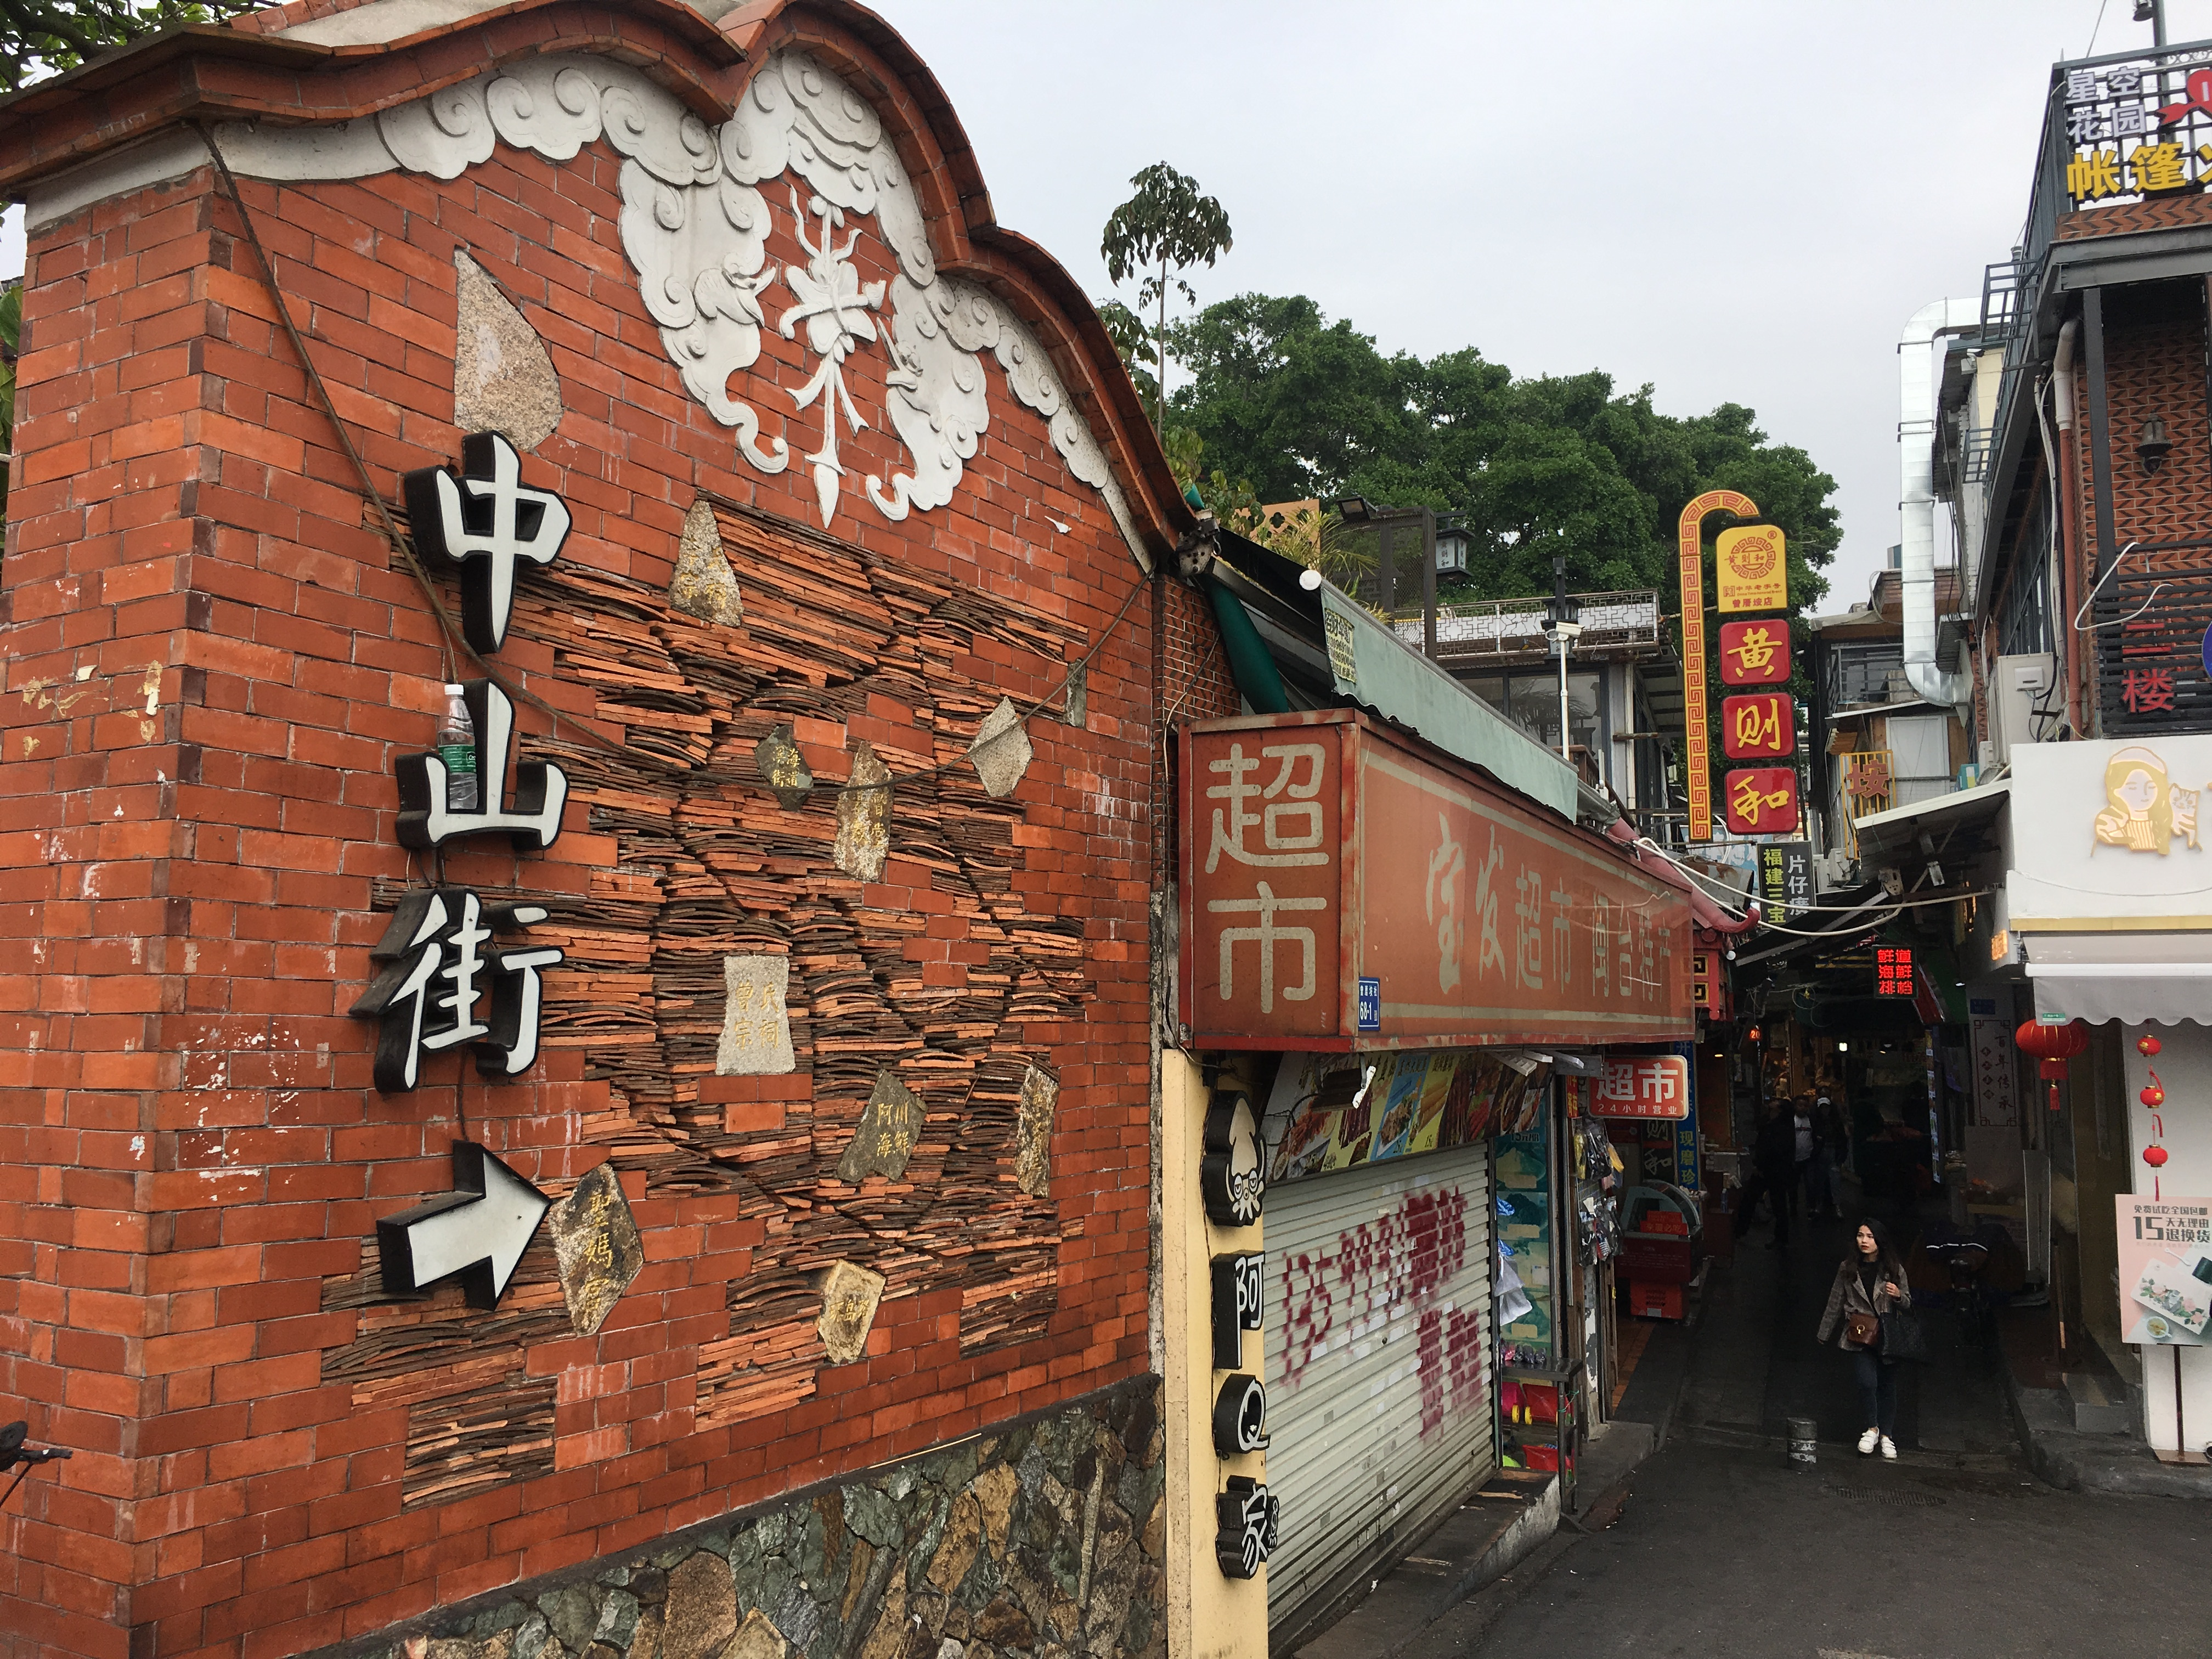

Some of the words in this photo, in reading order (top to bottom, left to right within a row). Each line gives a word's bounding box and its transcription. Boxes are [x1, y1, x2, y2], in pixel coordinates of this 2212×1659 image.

[2065, 66, 2140, 104] 星空
[2068, 104, 2146, 143] 花园
[2122, 622, 2176, 713] 二楼
[1727, 628, 1790, 826] 黄则和
[388, 433, 572, 1088] 中山街
[1206, 742, 1330, 1014] 超市
[1763, 848, 1786, 923] 福建三宝
[1787, 854, 1809, 916] 片仔癀
[1879, 980, 1913, 994] 排档
[1360, 1001, 1372, 1020] 68-1
[1596, 1062, 1678, 1103] 超市
[1598, 1104, 1677, 1115] 24小时营业
[877, 1131, 909, 1158] 海鲜
[2132, 1216, 2164, 1240] 15
[2165, 1217, 2209, 1228] 天无理由
[2134, 1205, 2208, 1215] 免费试吃全国包邮
[2165, 1228, 2210, 1243] 退换货
